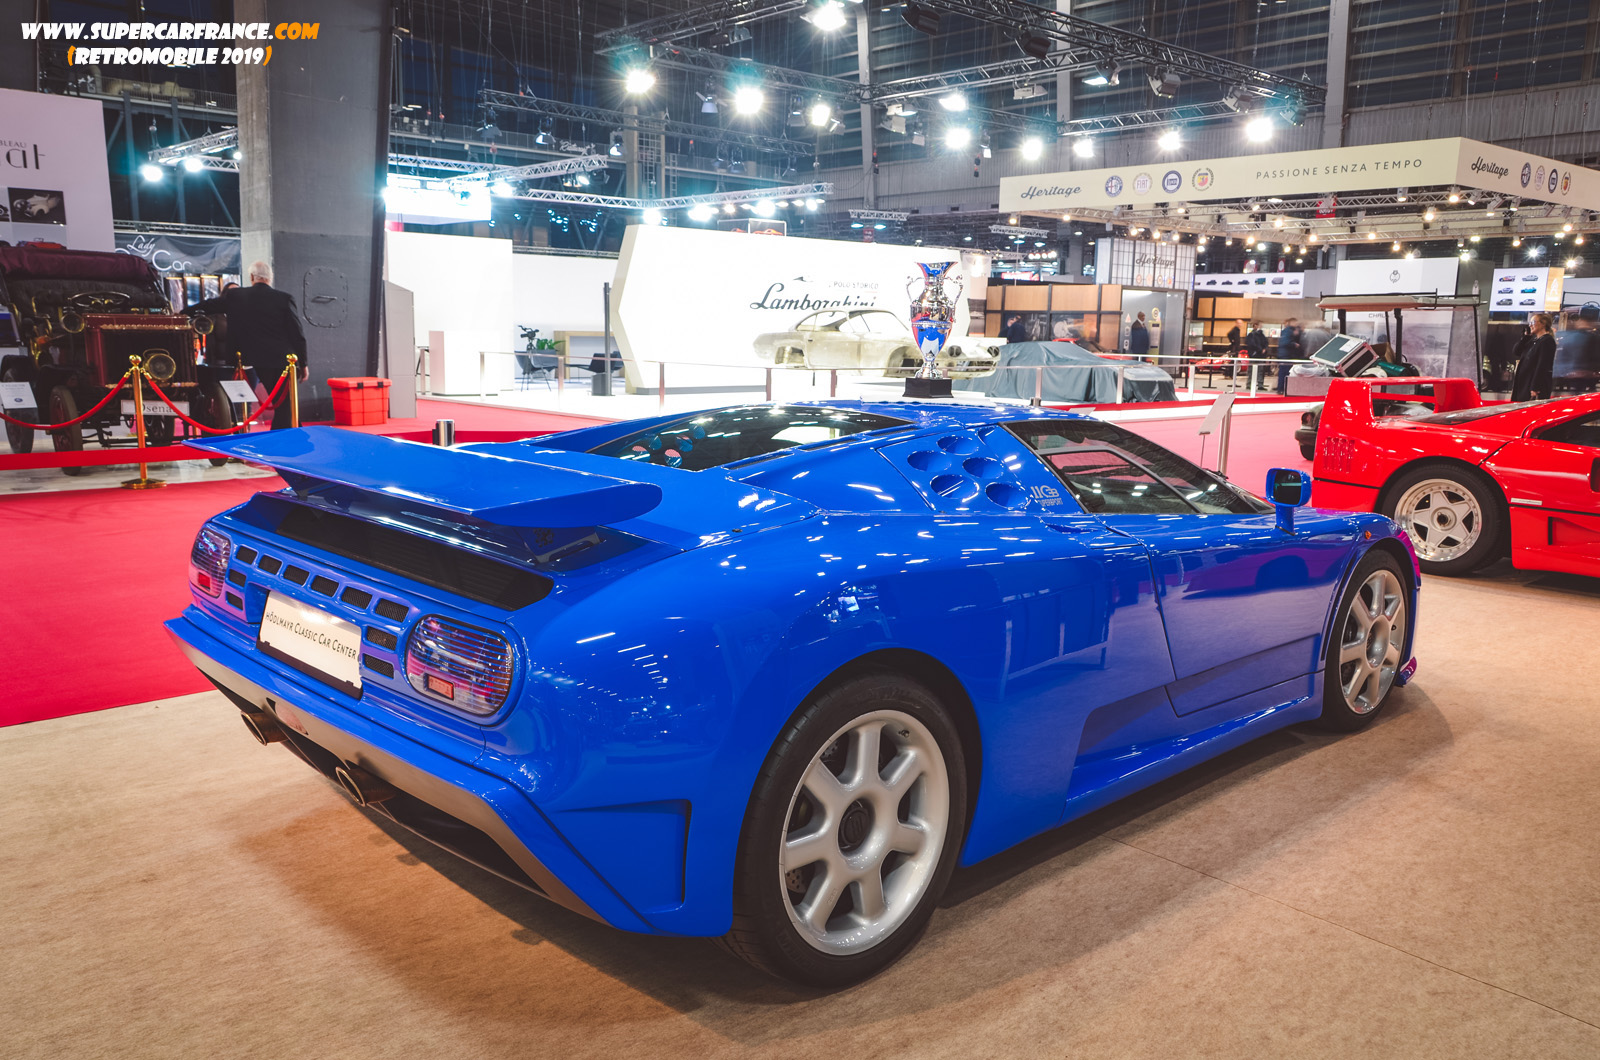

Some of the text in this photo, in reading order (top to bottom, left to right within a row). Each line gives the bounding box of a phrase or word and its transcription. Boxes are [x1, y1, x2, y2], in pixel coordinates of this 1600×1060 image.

[0, 144, 46, 170] at
[1471, 156, 1509, 179] Heritage
[1256, 158, 1423, 179] PASSIONE SENZA TEMPO
[1020, 185, 1082, 200] Heritage
[1136, 179, 1149, 189] FIAT
[127, 234, 155, 257] Lady
[152, 249, 192, 271] Car
[1135, 252, 1176, 269] Heritage
[141, 402, 176, 413] sena
